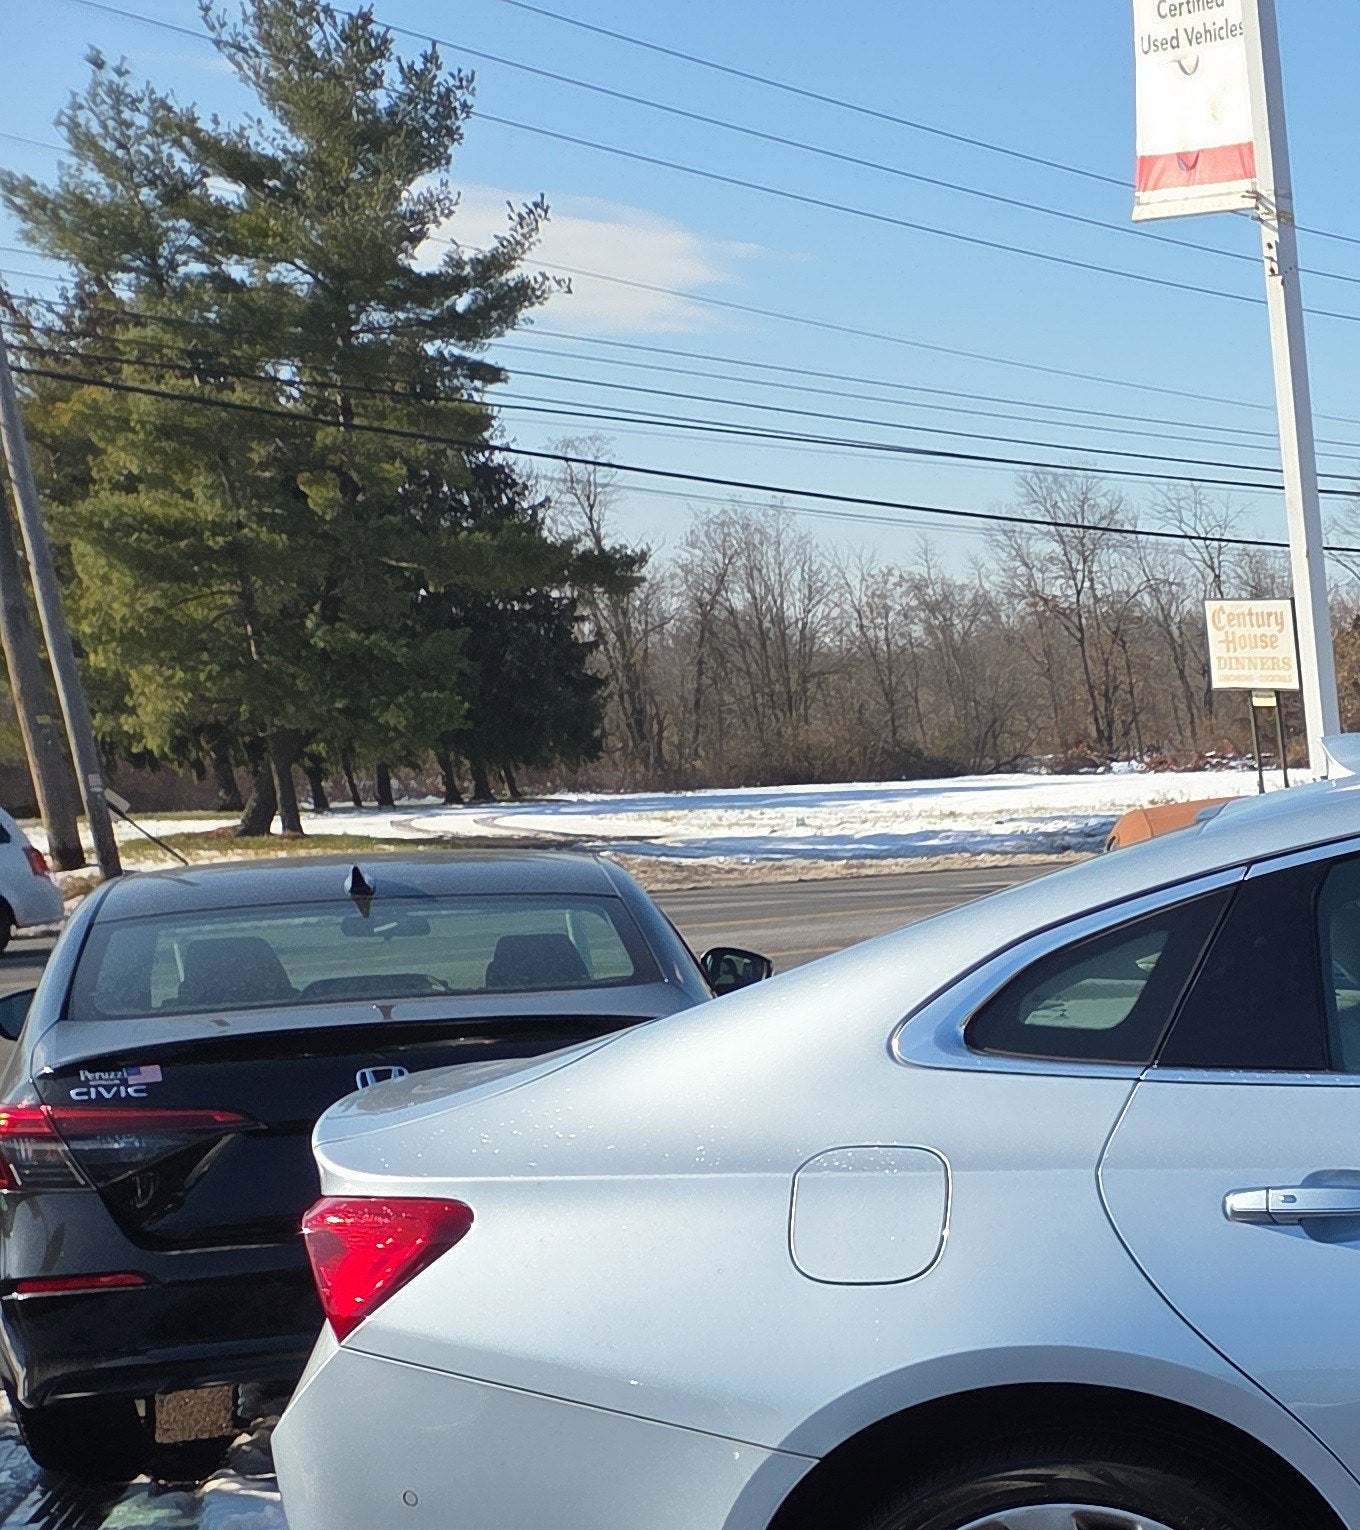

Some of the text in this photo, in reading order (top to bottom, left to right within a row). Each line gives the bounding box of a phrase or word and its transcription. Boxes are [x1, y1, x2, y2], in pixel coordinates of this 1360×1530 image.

[1140, 18, 1244, 55] Used Vehicles
[1211, 604, 1285, 634] Century
[1218, 629, 1280, 654] House
[1216, 655, 1293, 671] DINNERS
[79, 1067, 128, 1081] Peruzzi
[69, 1085, 149, 1101] CIVIC
